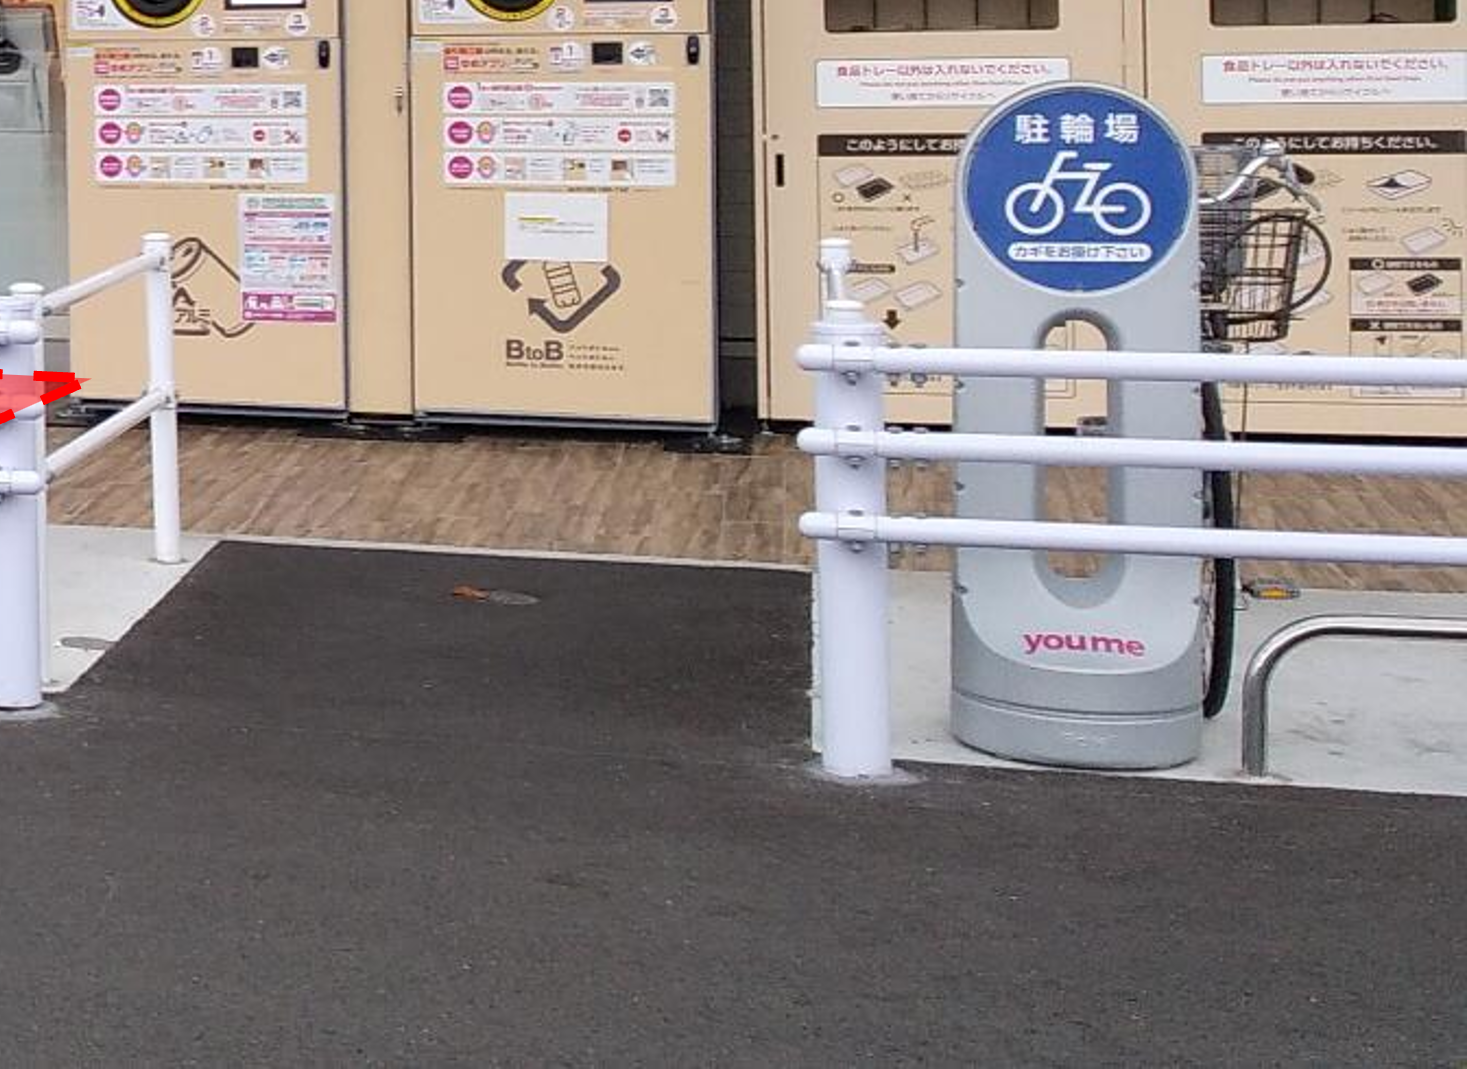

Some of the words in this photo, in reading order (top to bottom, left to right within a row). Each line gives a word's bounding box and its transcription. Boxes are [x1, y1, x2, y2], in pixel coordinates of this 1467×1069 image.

[837, 63, 1051, 77] 食品トレー以外は入れないでください。
[1222, 58, 1449, 73] 食品トレー以外は入れないでください。
[1013, 112, 1141, 144] 駐輪場
[174, 308, 210, 325] アルミ
[1023, 633, 1146, 657] youme
